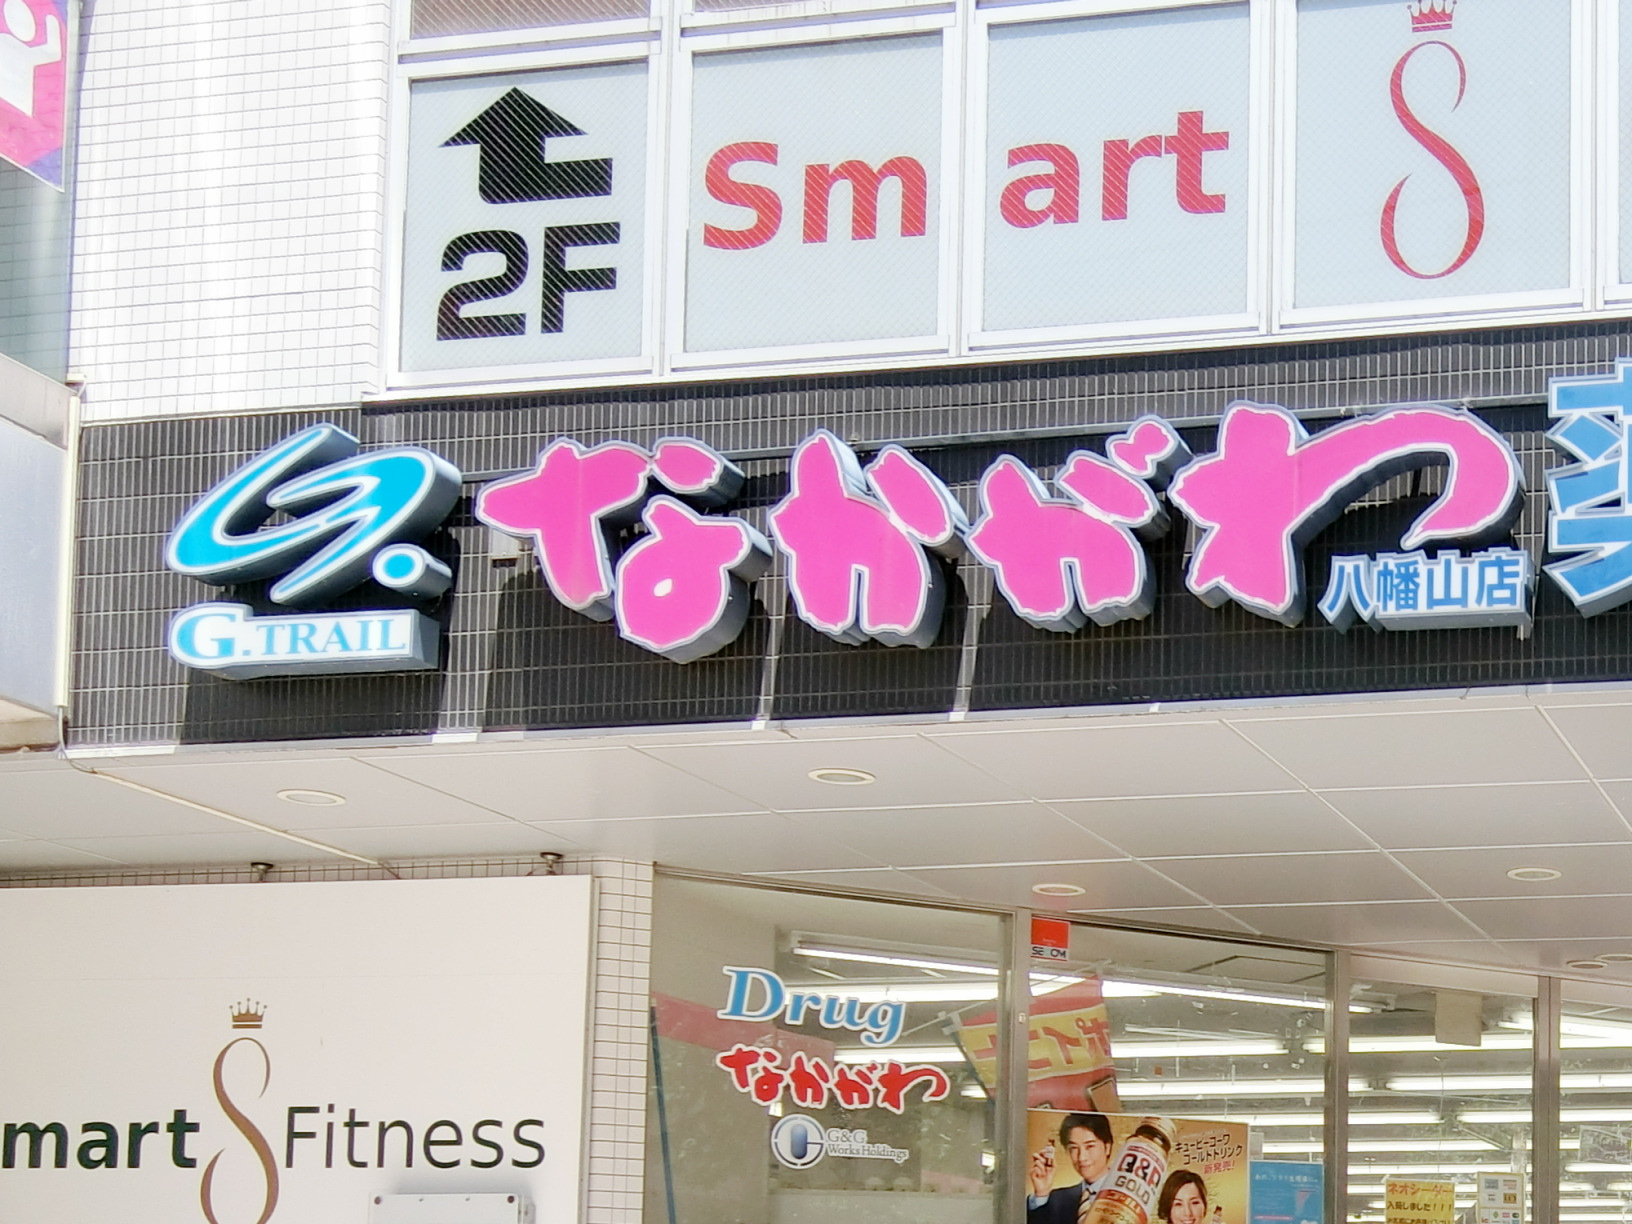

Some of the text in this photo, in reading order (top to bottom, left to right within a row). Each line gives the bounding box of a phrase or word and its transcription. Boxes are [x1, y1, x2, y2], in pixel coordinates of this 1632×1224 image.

[703, 110, 1230, 250] Smart
[436, 222, 620, 342] 2F
[478, 404, 1522, 653] なかがわ
[1327, 556, 1520, 613] 八幡山店
[176, 613, 405, 659] G.TRAIL
[717, 965, 906, 1048] Drug
[716, 1044, 950, 1114] なかがわ
[1, 1109, 200, 1169] mart
[286, 1104, 545, 1169] Fitness
[827, 1130, 866, 1144] G&G
[1115, 1175, 1150, 1206] GOLD
